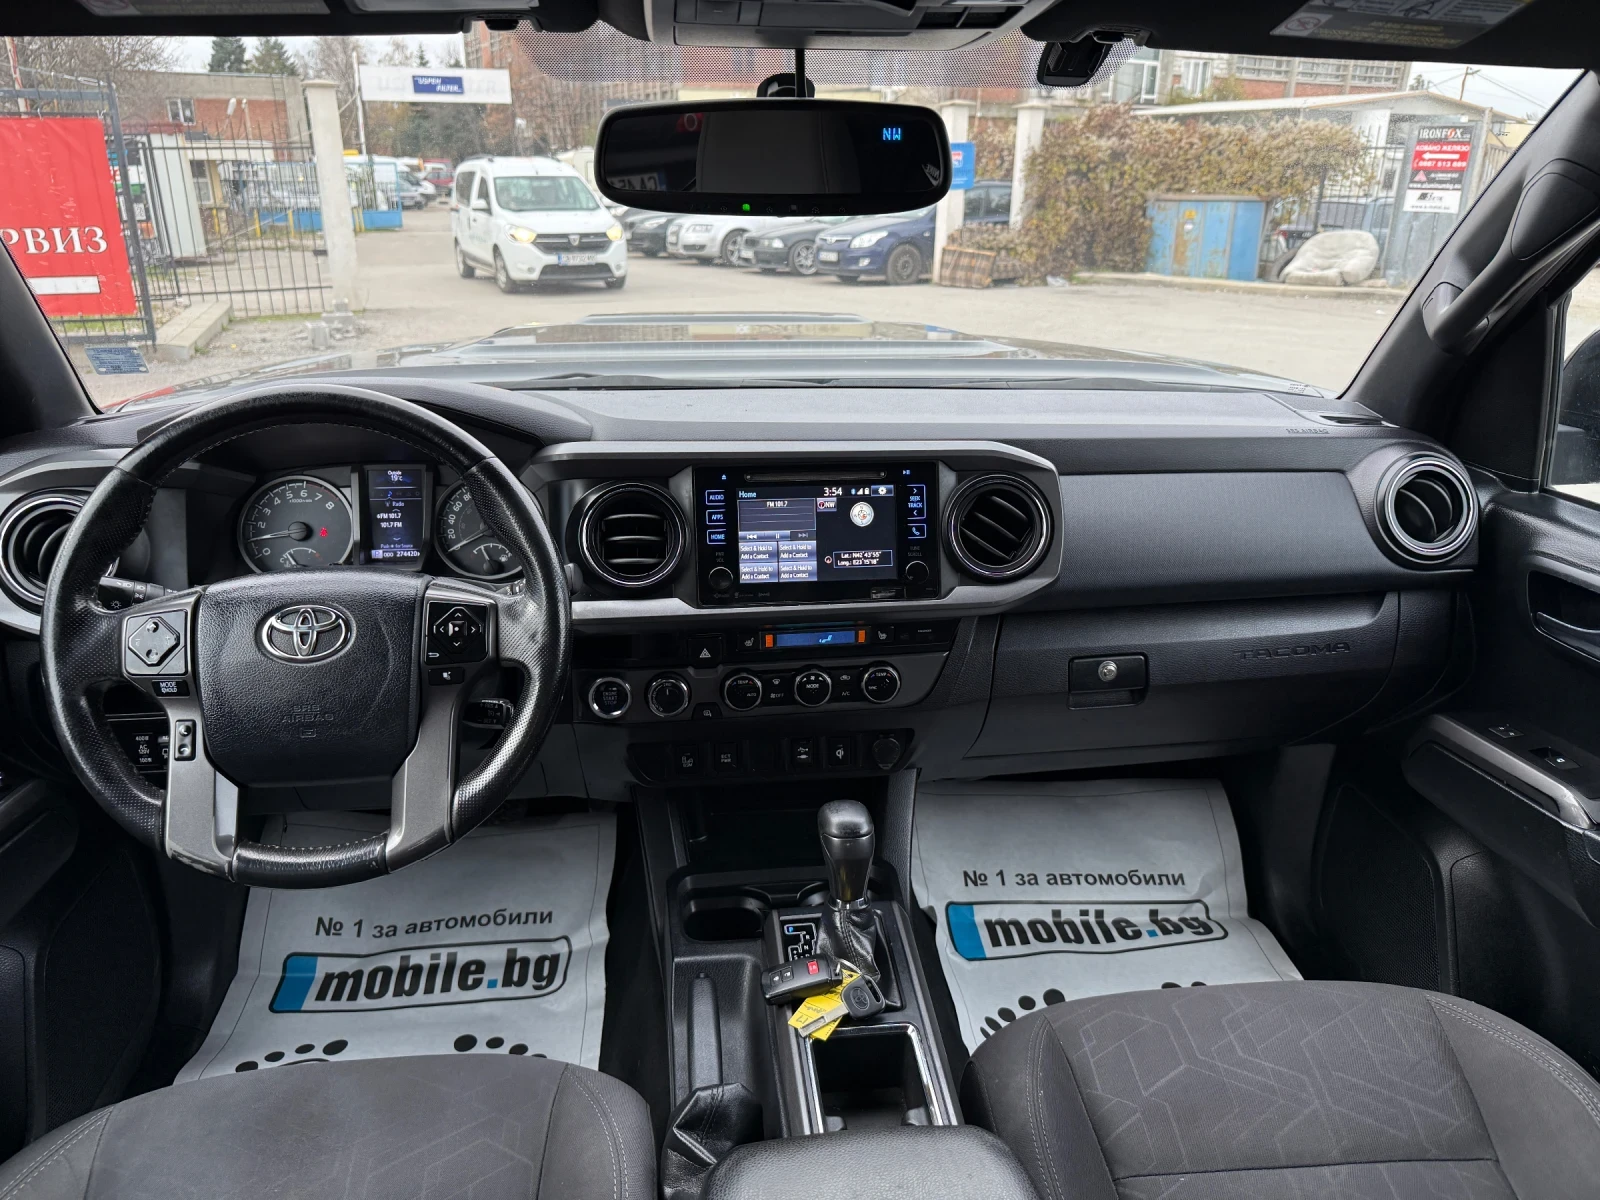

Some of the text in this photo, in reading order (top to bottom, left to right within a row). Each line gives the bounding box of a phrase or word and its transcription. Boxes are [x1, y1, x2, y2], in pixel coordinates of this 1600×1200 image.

[882, 127, 901, 141] NW
[286, 491, 294, 500] 5
[300, 490, 308, 498] 6
[314, 492, 322, 501] 7
[824, 488, 842, 496] 3:54
[274, 496, 281, 506] 4
[326, 501, 334, 510] 8
[452, 501, 462, 512] 60
[262, 508, 271, 516] 3
[258, 521, 266, 529] 2
[448, 514, 456, 526] 40
[448, 528, 456, 540] 20
[262, 548, 270, 556] 0
[1233, 642, 1351, 660] TACOMA
[282, 714, 334, 722] AIRBAG
[996, 869, 1006, 886] 1
[1016, 873, 1039, 886] за
[1046, 870, 1185, 887] автомобили
[354, 918, 364, 938] 1
[372, 924, 398, 939] за
[405, 908, 553, 935] автомобили
[984, 908, 1214, 948] mobile.bg
[315, 947, 561, 1001] mobile.bg
